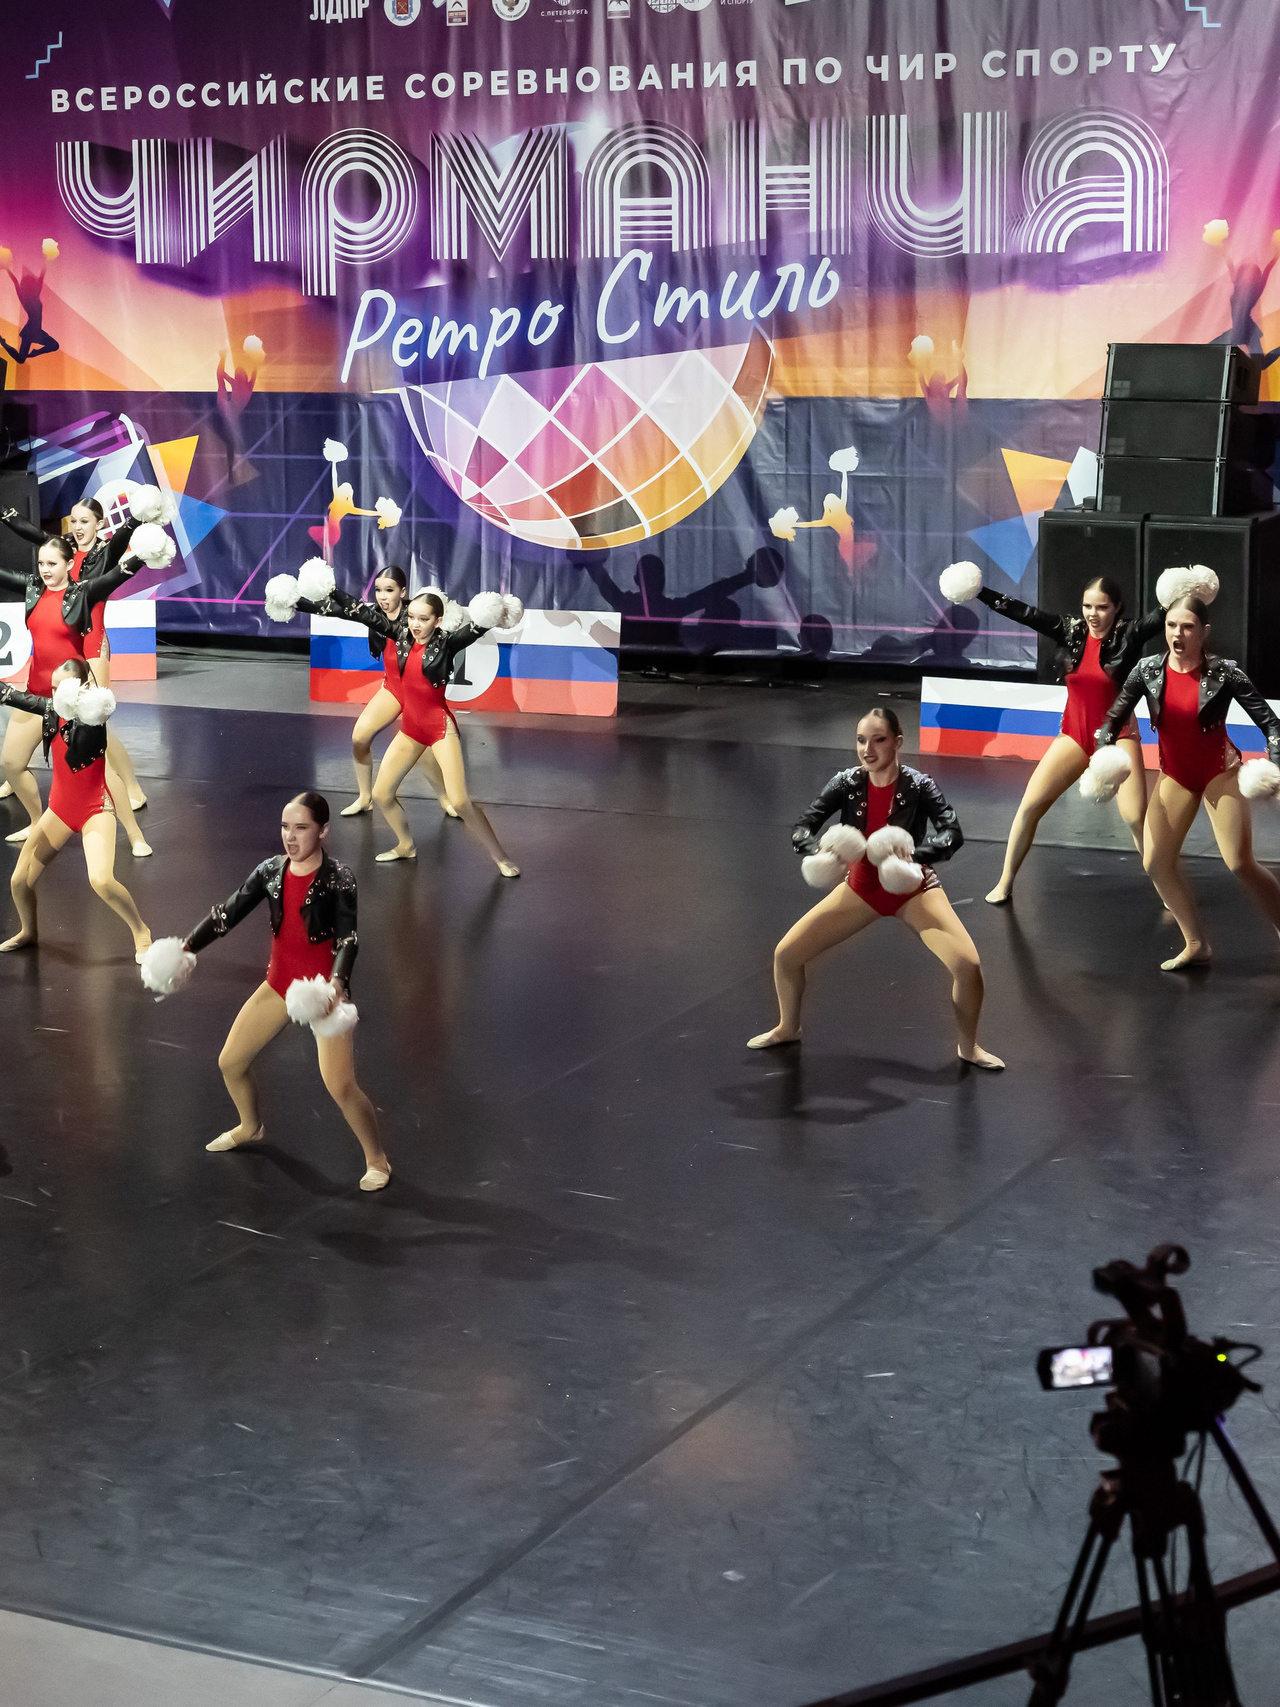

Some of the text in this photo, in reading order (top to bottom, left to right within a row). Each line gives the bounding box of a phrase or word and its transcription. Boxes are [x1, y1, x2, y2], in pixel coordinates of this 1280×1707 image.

[309, 0, 370, 24] ЛДПР
[51, 43, 1178, 113] ВСЕРОССИЙСКИЕ СОРЕВНОВАНИЯ ПО ЧИР СПОРТУ
[341, 249, 841, 383] Ретро Стиль
